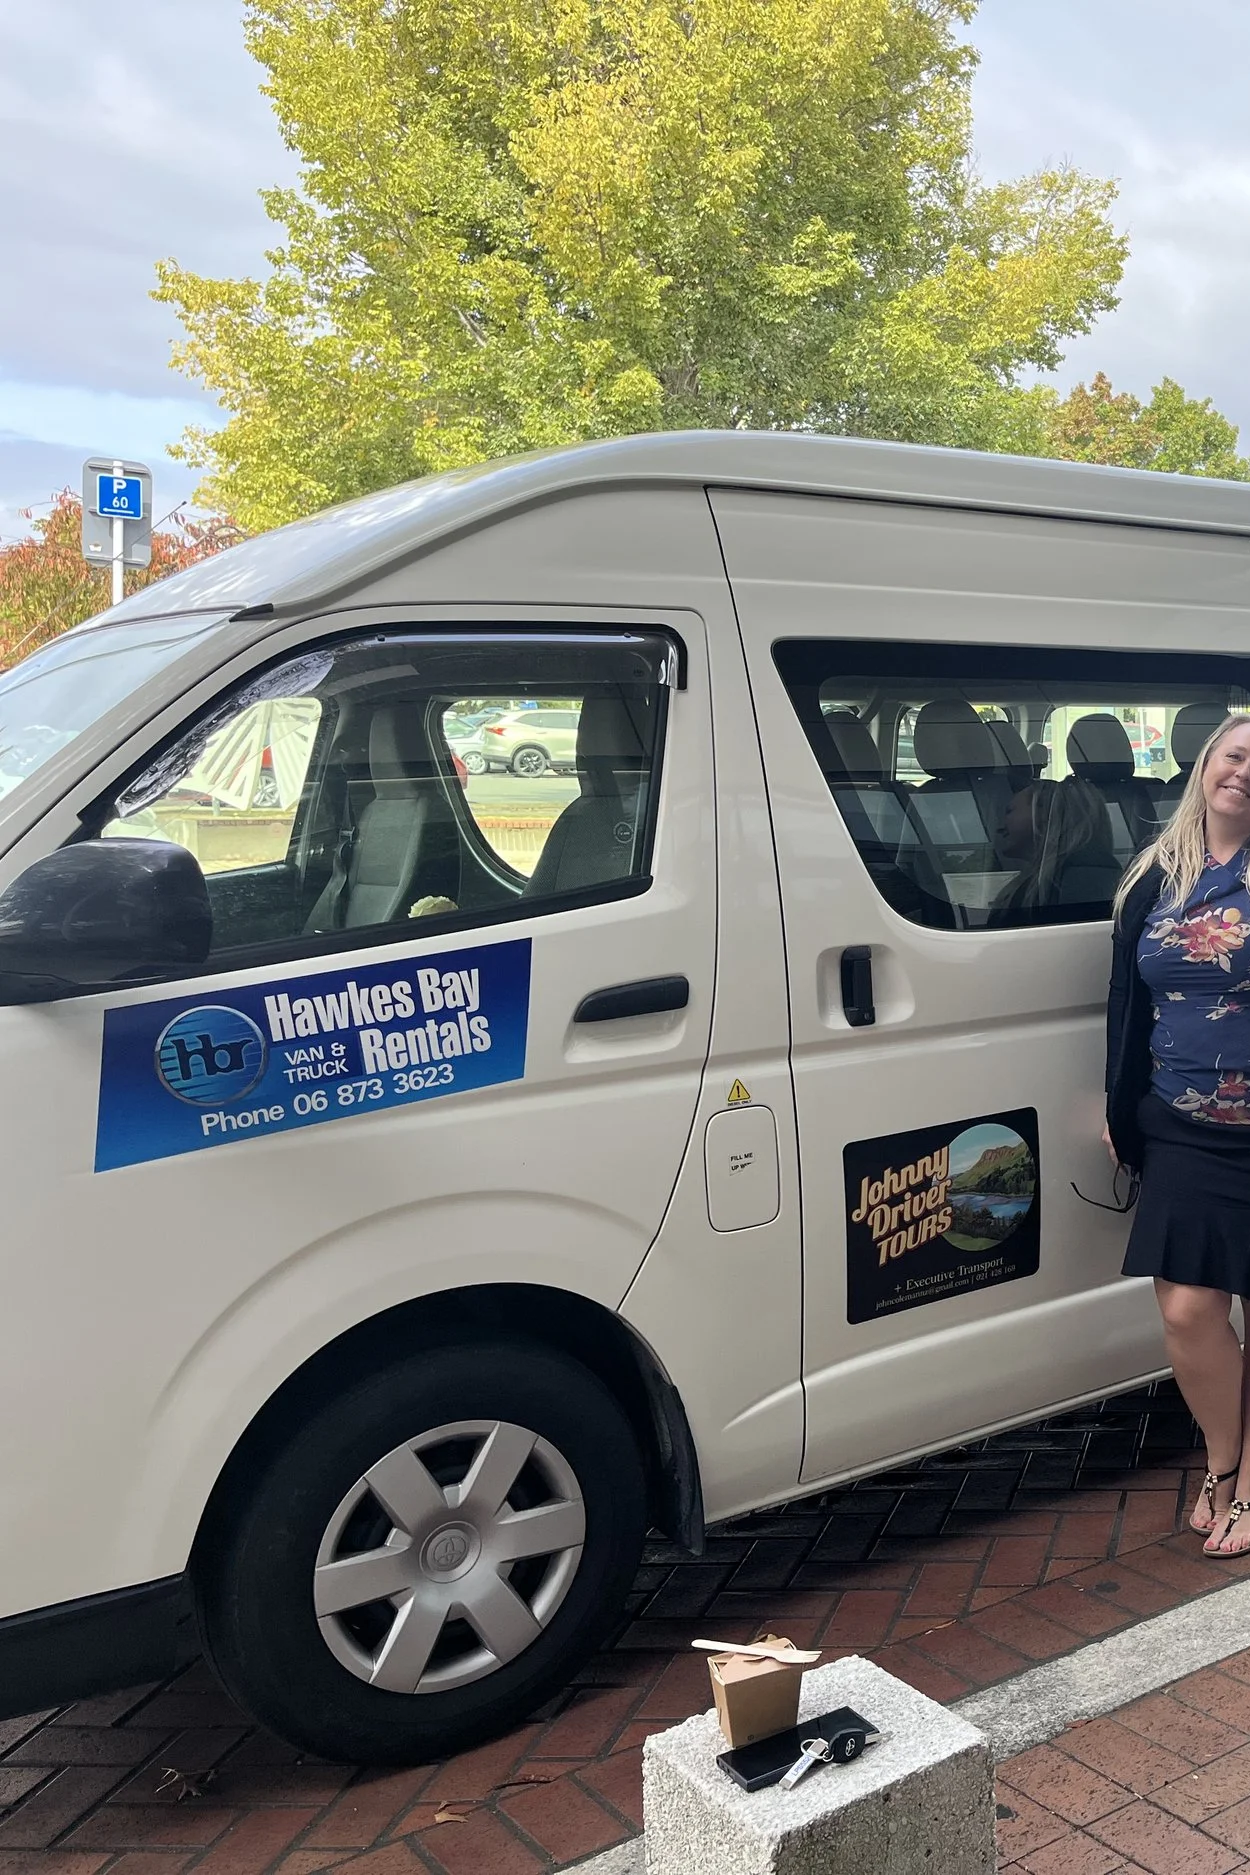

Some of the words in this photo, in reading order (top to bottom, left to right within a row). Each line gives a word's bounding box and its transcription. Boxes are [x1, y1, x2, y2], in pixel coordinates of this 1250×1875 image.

[112, 496, 128, 508] 60
[113, 478, 127, 494] P
[264, 981, 415, 1043] Hawkes
[416, 968, 480, 1014] Bay
[284, 1045, 325, 1066] VAN
[331, 1042, 347, 1057] &
[359, 1010, 492, 1075] Rentals
[283, 1058, 349, 1084] TRUCK
[200, 1105, 286, 1137] Phone
[293, 1089, 329, 1115] 06
[336, 1078, 385, 1106] 873
[392, 1063, 455, 1094] 3623
[730, 1154, 743, 1162] FILL
[851, 1145, 949, 1222] Johnny
[867, 1179, 952, 1241] Driver
[876, 1206, 953, 1267] TOURS
[905, 1268, 955, 1291] Executive
[956, 1256, 1004, 1277] Transport
